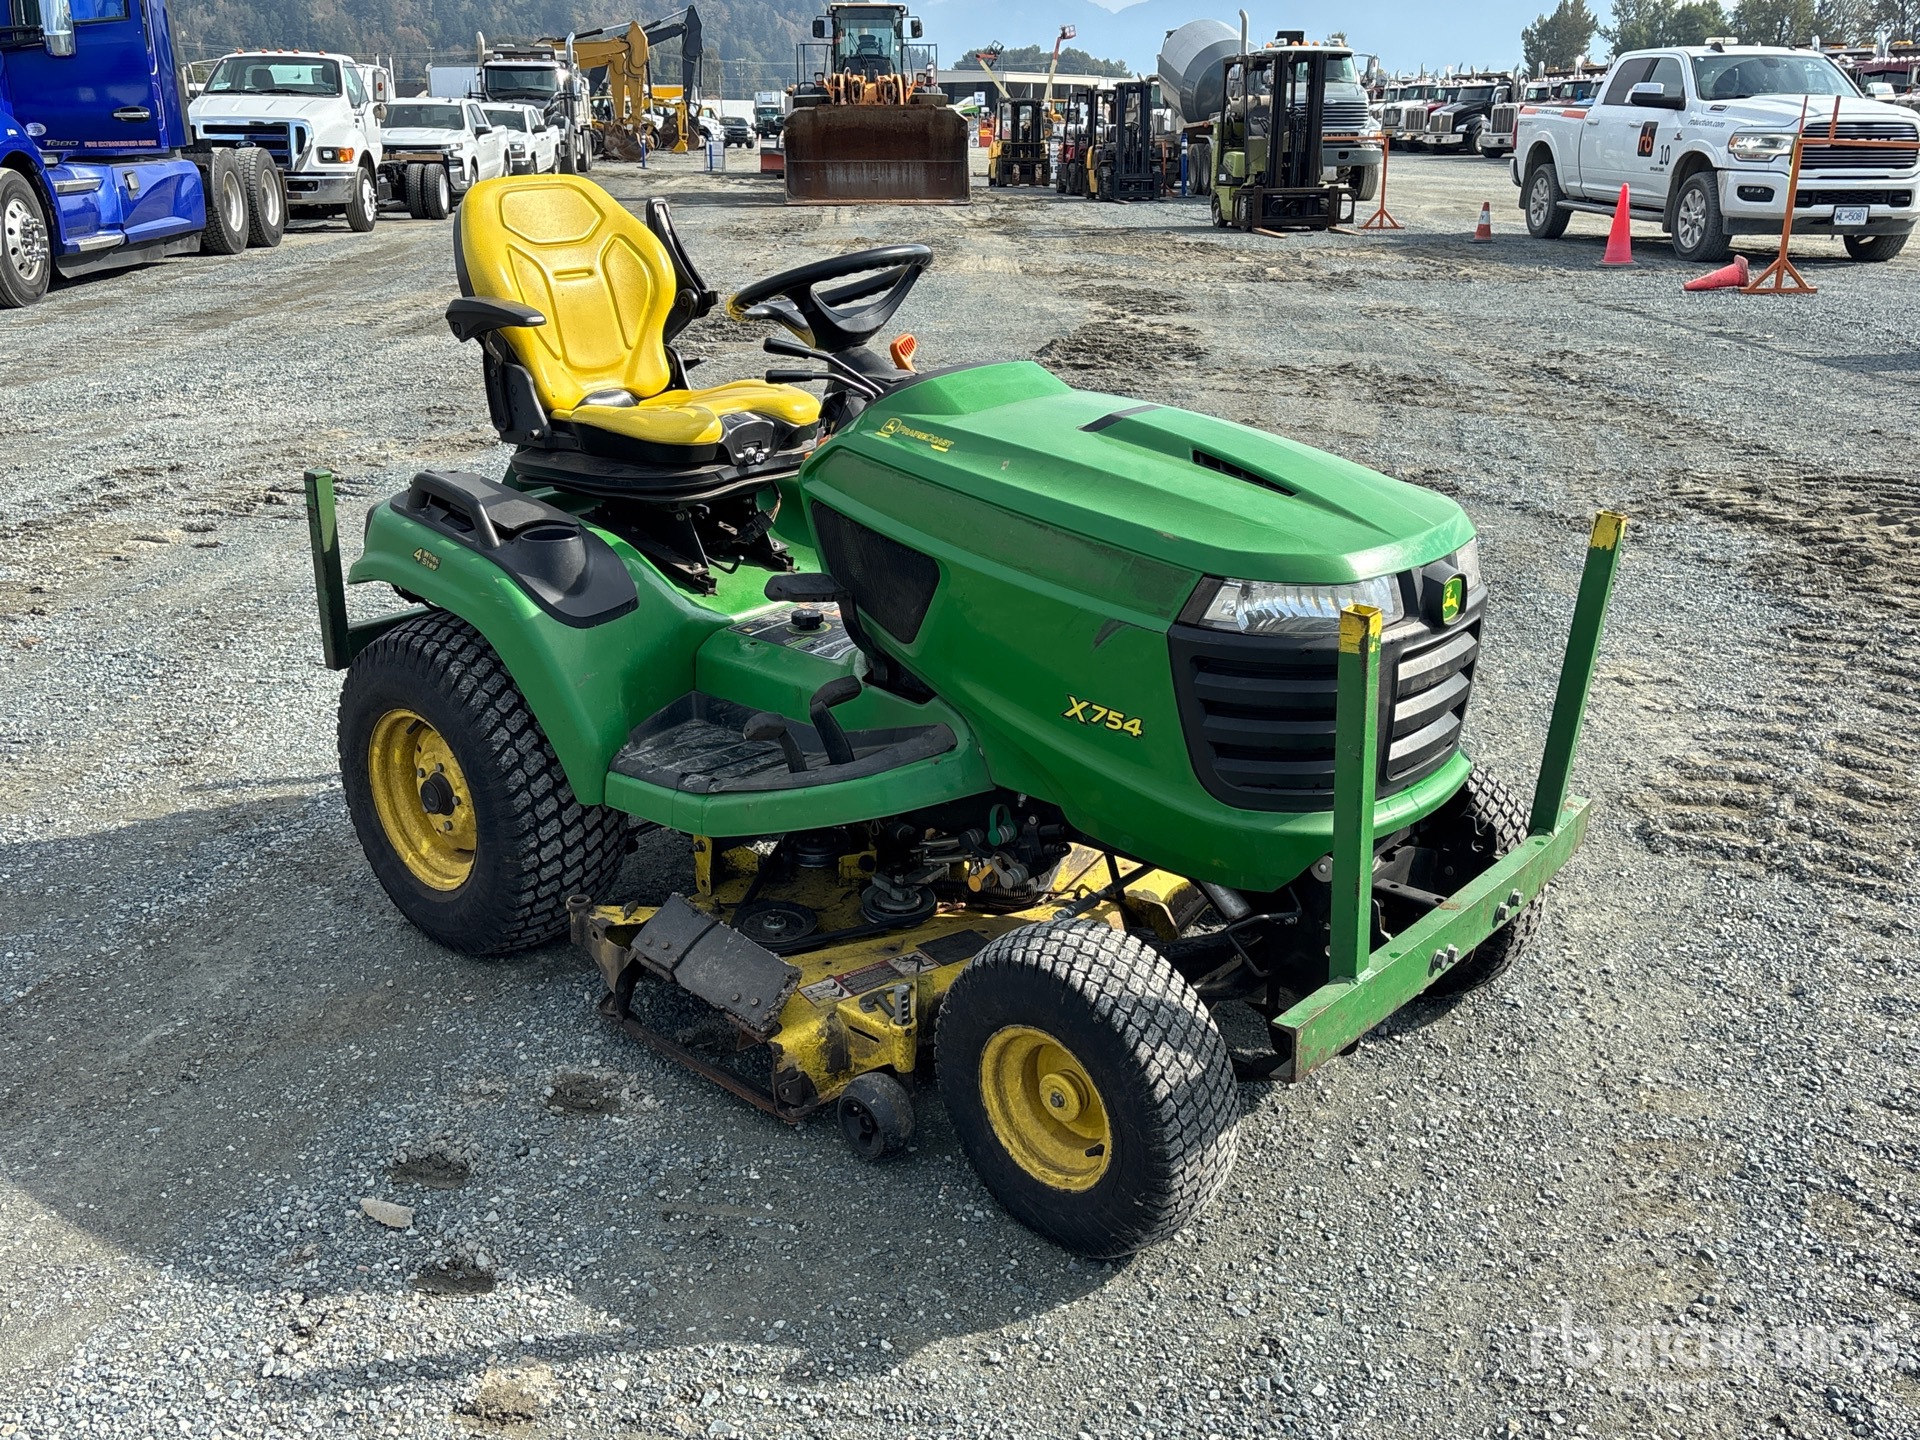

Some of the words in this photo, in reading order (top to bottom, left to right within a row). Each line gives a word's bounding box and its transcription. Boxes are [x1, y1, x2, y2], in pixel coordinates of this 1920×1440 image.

[43, 139, 79, 147] T680
[1659, 144, 1671, 166] 10
[413, 548, 423, 562] 4
[1062, 694, 1143, 737] X754
